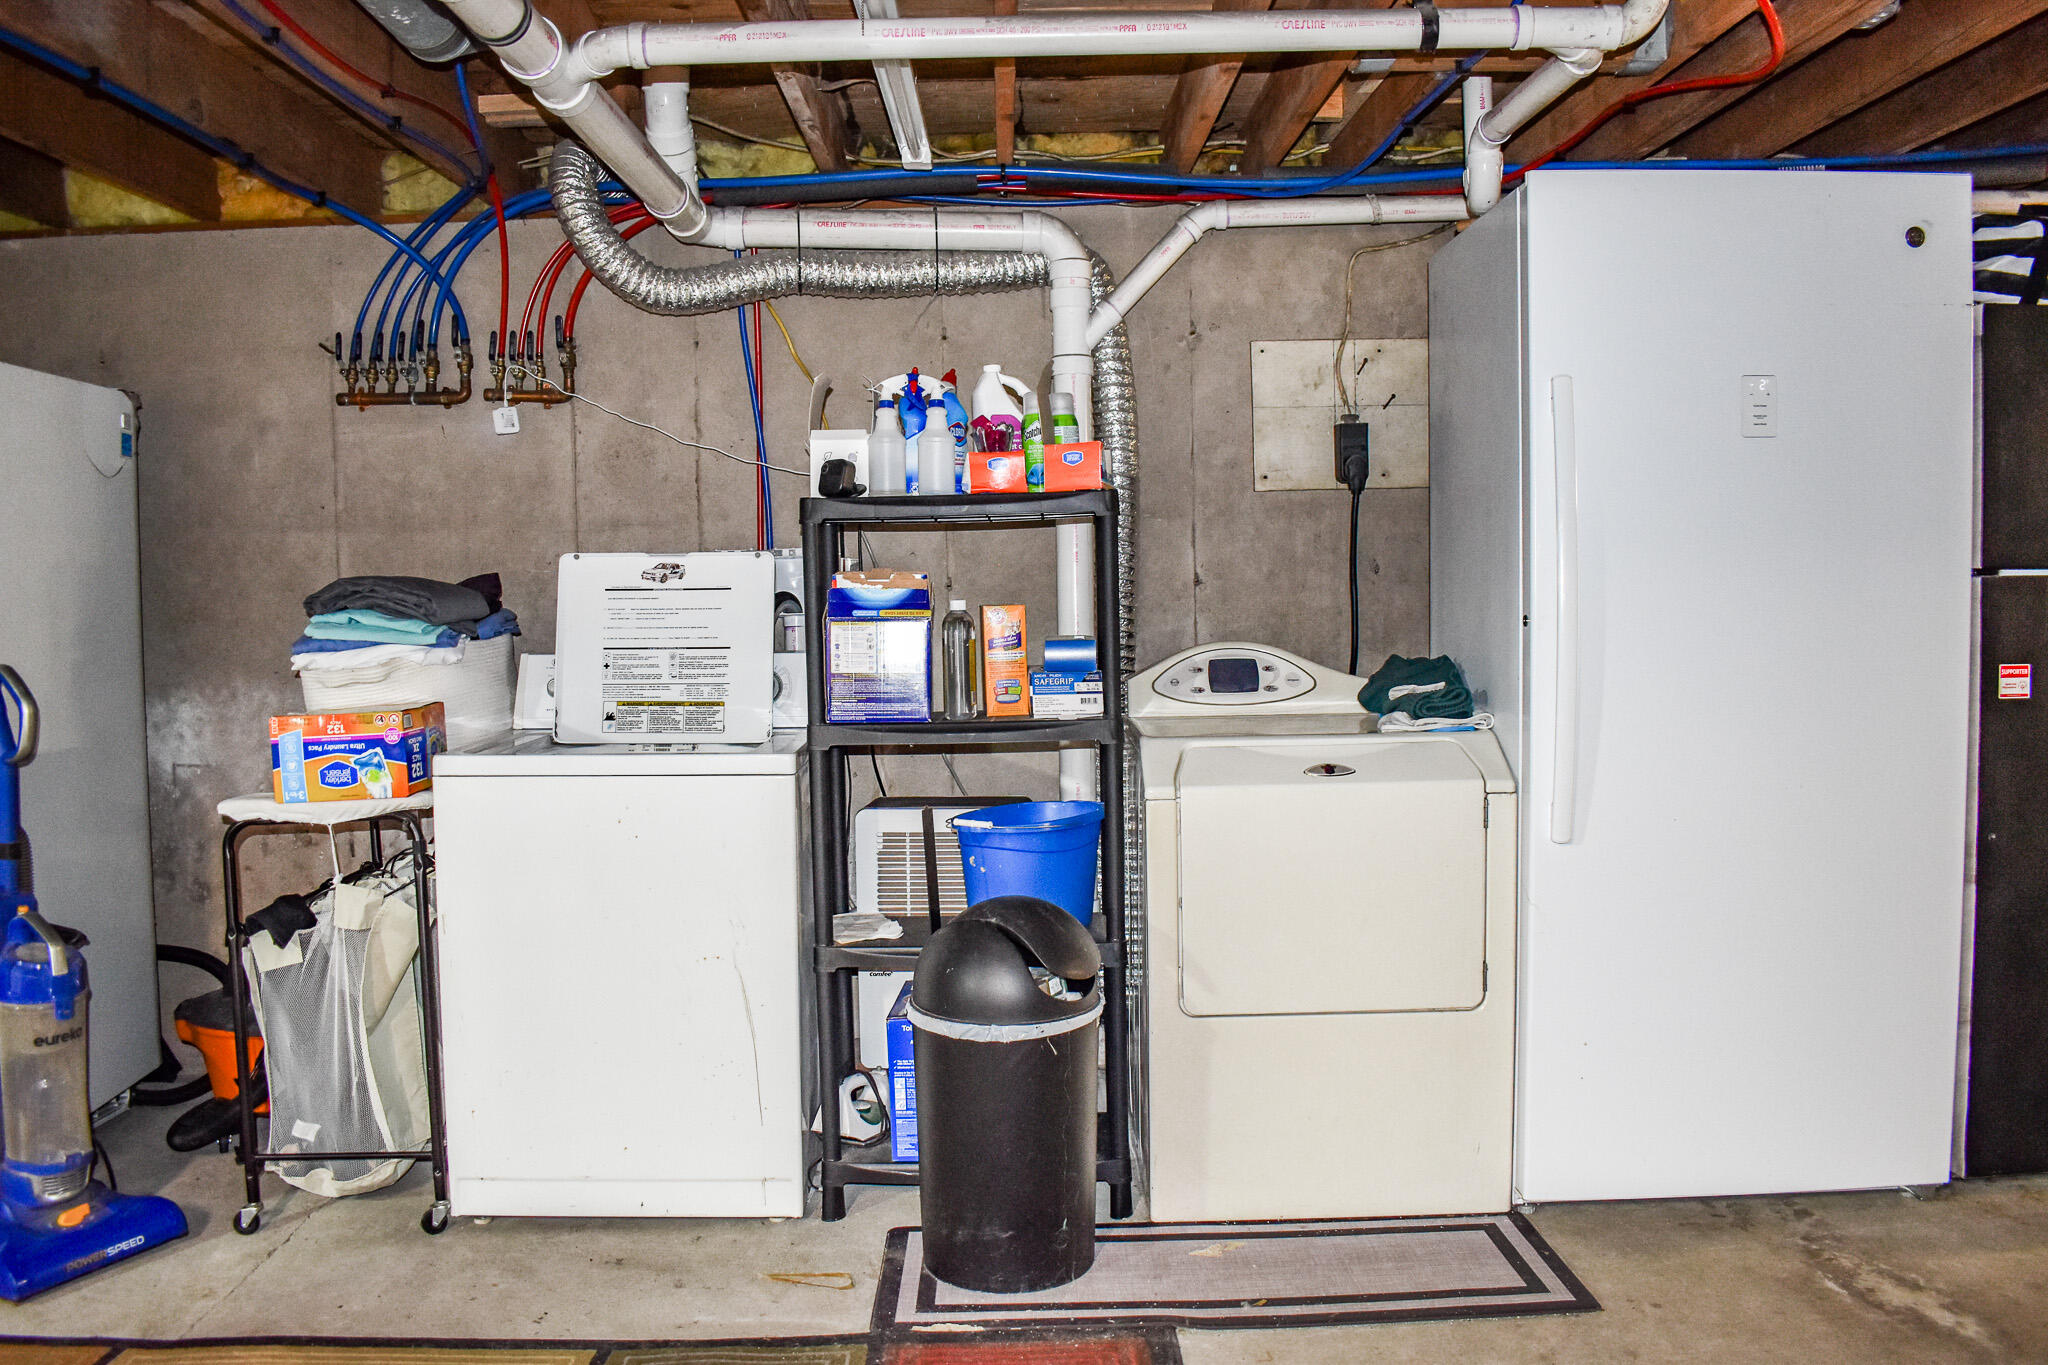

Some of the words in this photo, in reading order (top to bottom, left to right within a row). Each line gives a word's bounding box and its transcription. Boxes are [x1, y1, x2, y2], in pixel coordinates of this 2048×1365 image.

[1034, 677, 1074, 686] SAFEGRIP
[327, 725, 346, 734] 132
[308, 744, 323, 752] Pacs
[324, 742, 349, 751] Laundry
[349, 742, 366, 751] Ultra
[326, 766, 351, 777] jensen
[410, 761, 424, 779] 132
[325, 774, 352, 785] berkley
[34, 1027, 82, 1047] eureka
